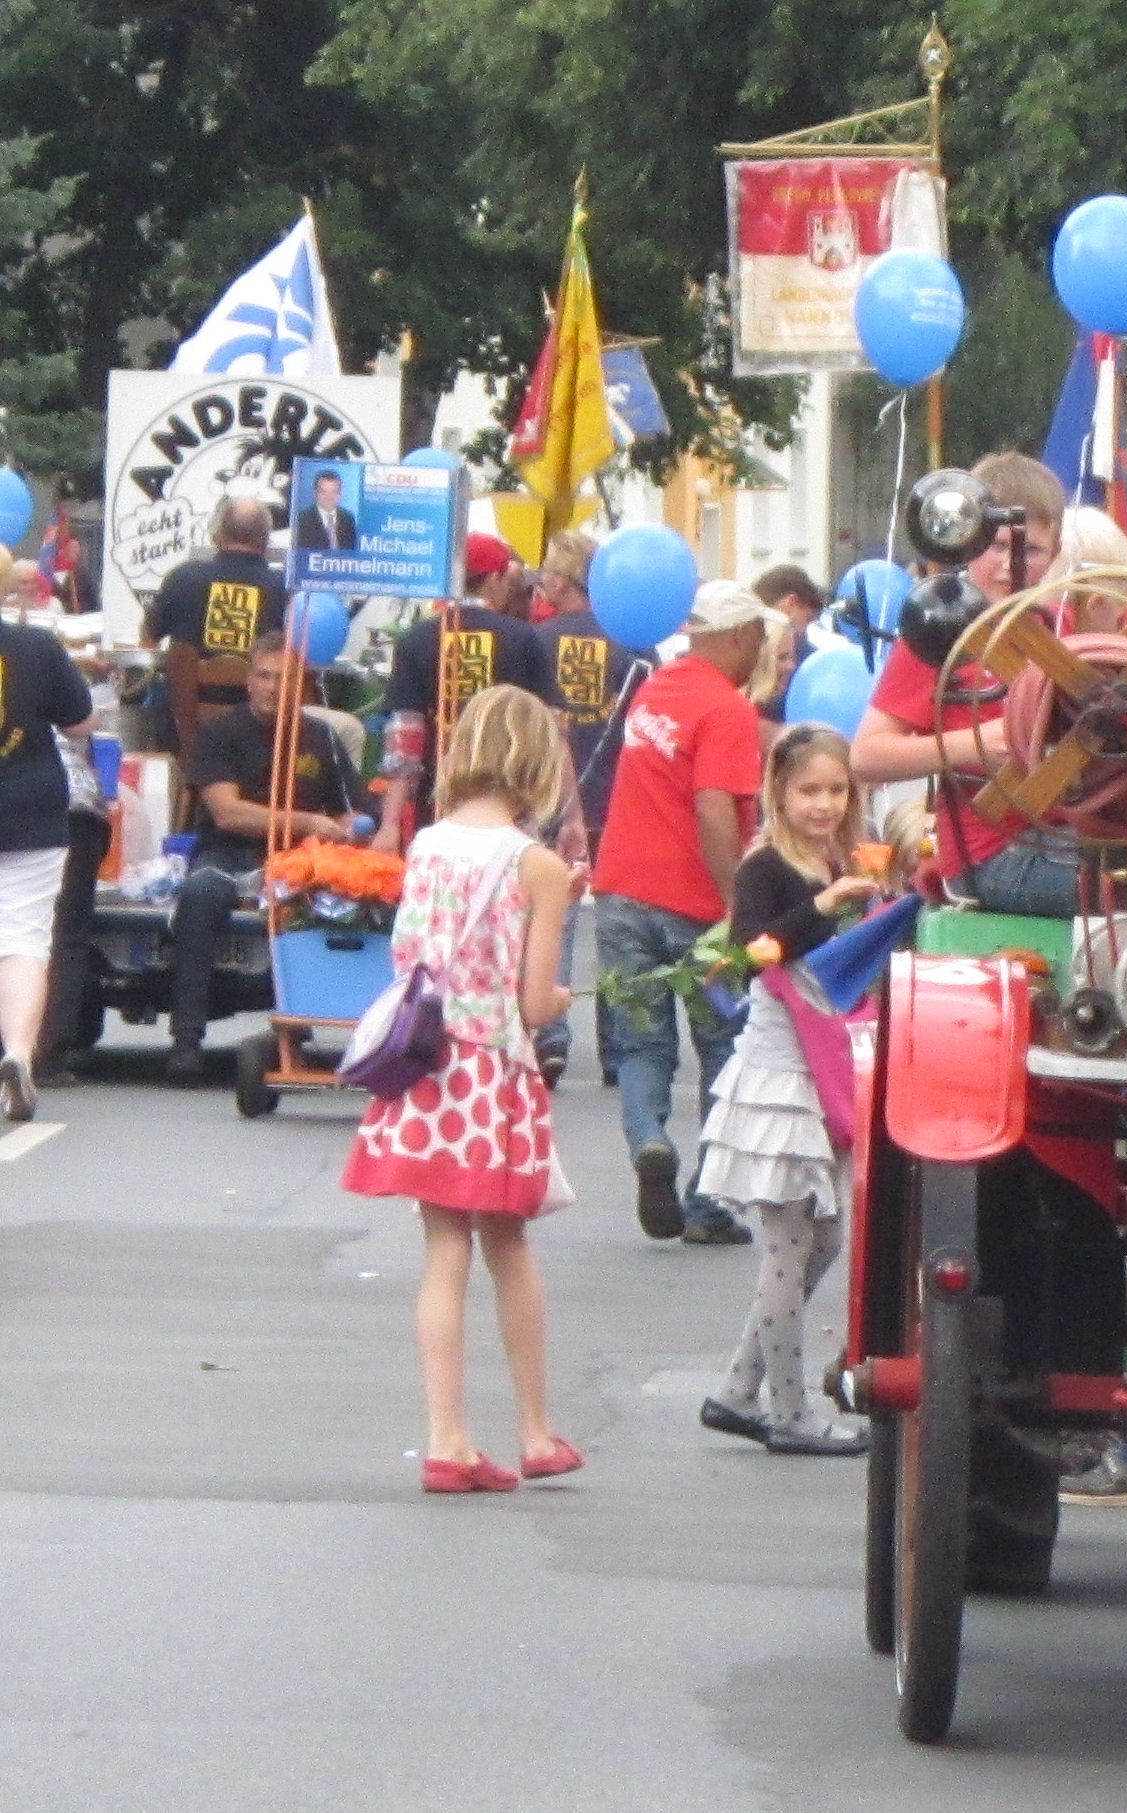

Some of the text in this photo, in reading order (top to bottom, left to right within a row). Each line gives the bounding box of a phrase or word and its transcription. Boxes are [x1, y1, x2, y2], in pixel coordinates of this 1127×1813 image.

[136, 508, 183, 537] echt
[380, 515, 434, 534] Jens-
[359, 535, 433, 555] Michael
[308, 552, 433, 577] Emmelmann
